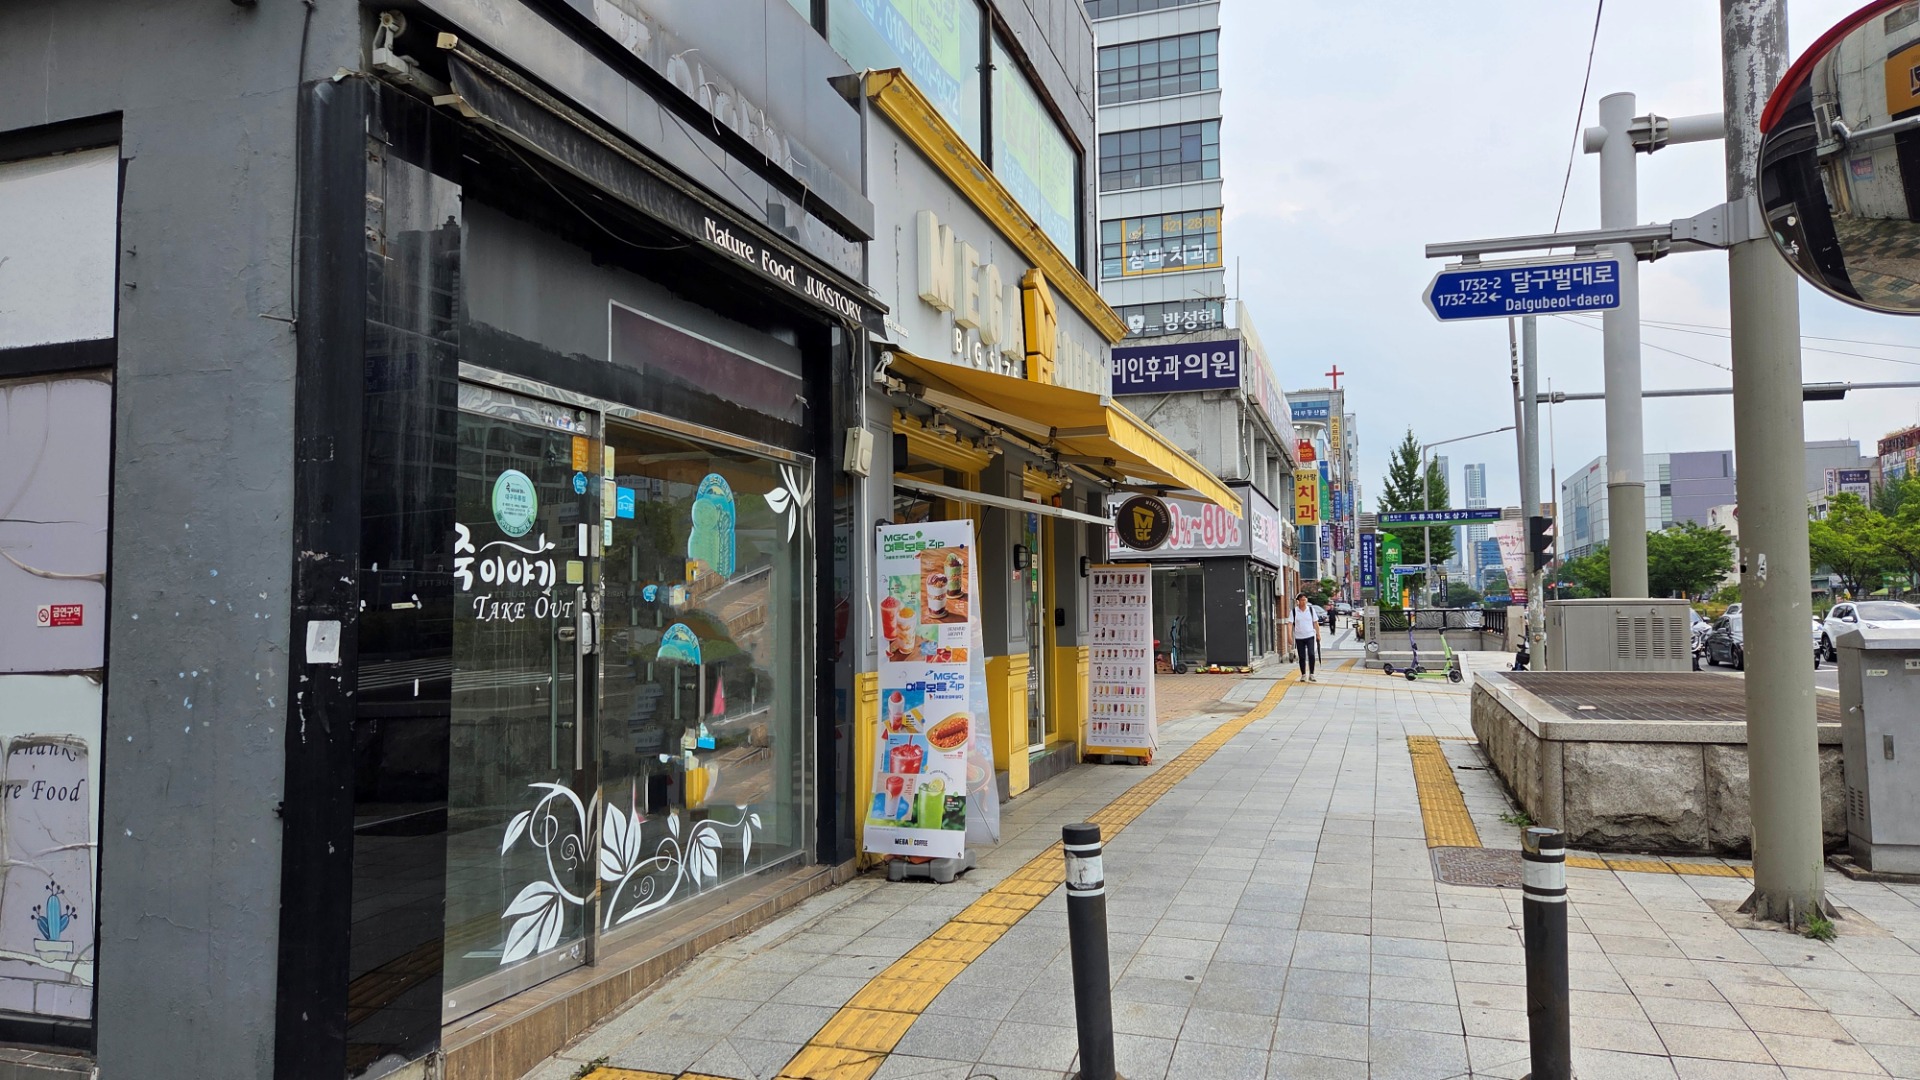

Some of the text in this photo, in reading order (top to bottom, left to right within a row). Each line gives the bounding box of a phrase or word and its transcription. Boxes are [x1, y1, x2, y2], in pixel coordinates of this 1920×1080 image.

[1163, 215, 1217, 233] 421-2876
[704, 216, 863, 323] Nature Food JUKSTORY
[1511, 265, 1615, 294] 달구벌대로
[917, 210, 1025, 362] MEGA
[1458, 277, 1502, 292] 1732-2
[1437, 292, 1488, 307] 1732-22
[1505, 293, 1615, 313] Dalgubeol-daero
[952, 327, 983, 367] BIG
[1112, 350, 1236, 384] 비인후과의원
[1298, 484, 1317, 521] 치과
[53, 606, 81, 618] 금연구역
[473, 593, 574, 622] TAKE OUT
[31, 778, 85, 802] Food
[894, 838, 928, 847] MEGA COFFEE
